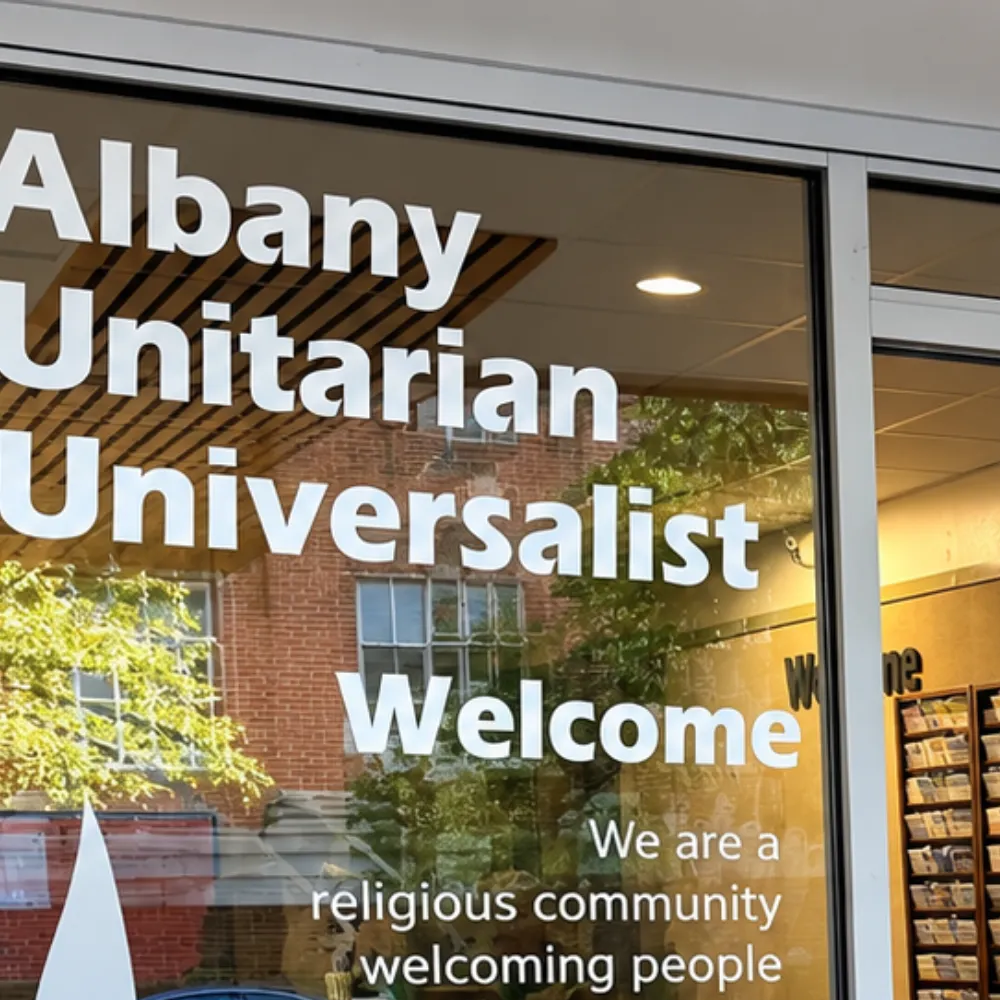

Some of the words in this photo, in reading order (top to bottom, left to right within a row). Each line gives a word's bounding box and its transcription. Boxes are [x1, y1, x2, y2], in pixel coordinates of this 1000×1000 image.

[0, 127, 481, 312] Albany
[0, 279, 619, 442] Unitarian
[0, 429, 759, 591] Universalist
[336, 671, 801, 768] Welcome
[588, 818, 660, 859] We
[676, 831, 743, 861] are
[757, 832, 780, 861] a
[311, 881, 518, 930] religious
[534, 883, 782, 931] community
[359, 944, 613, 993] welcoming
[633, 943, 782, 992] people
